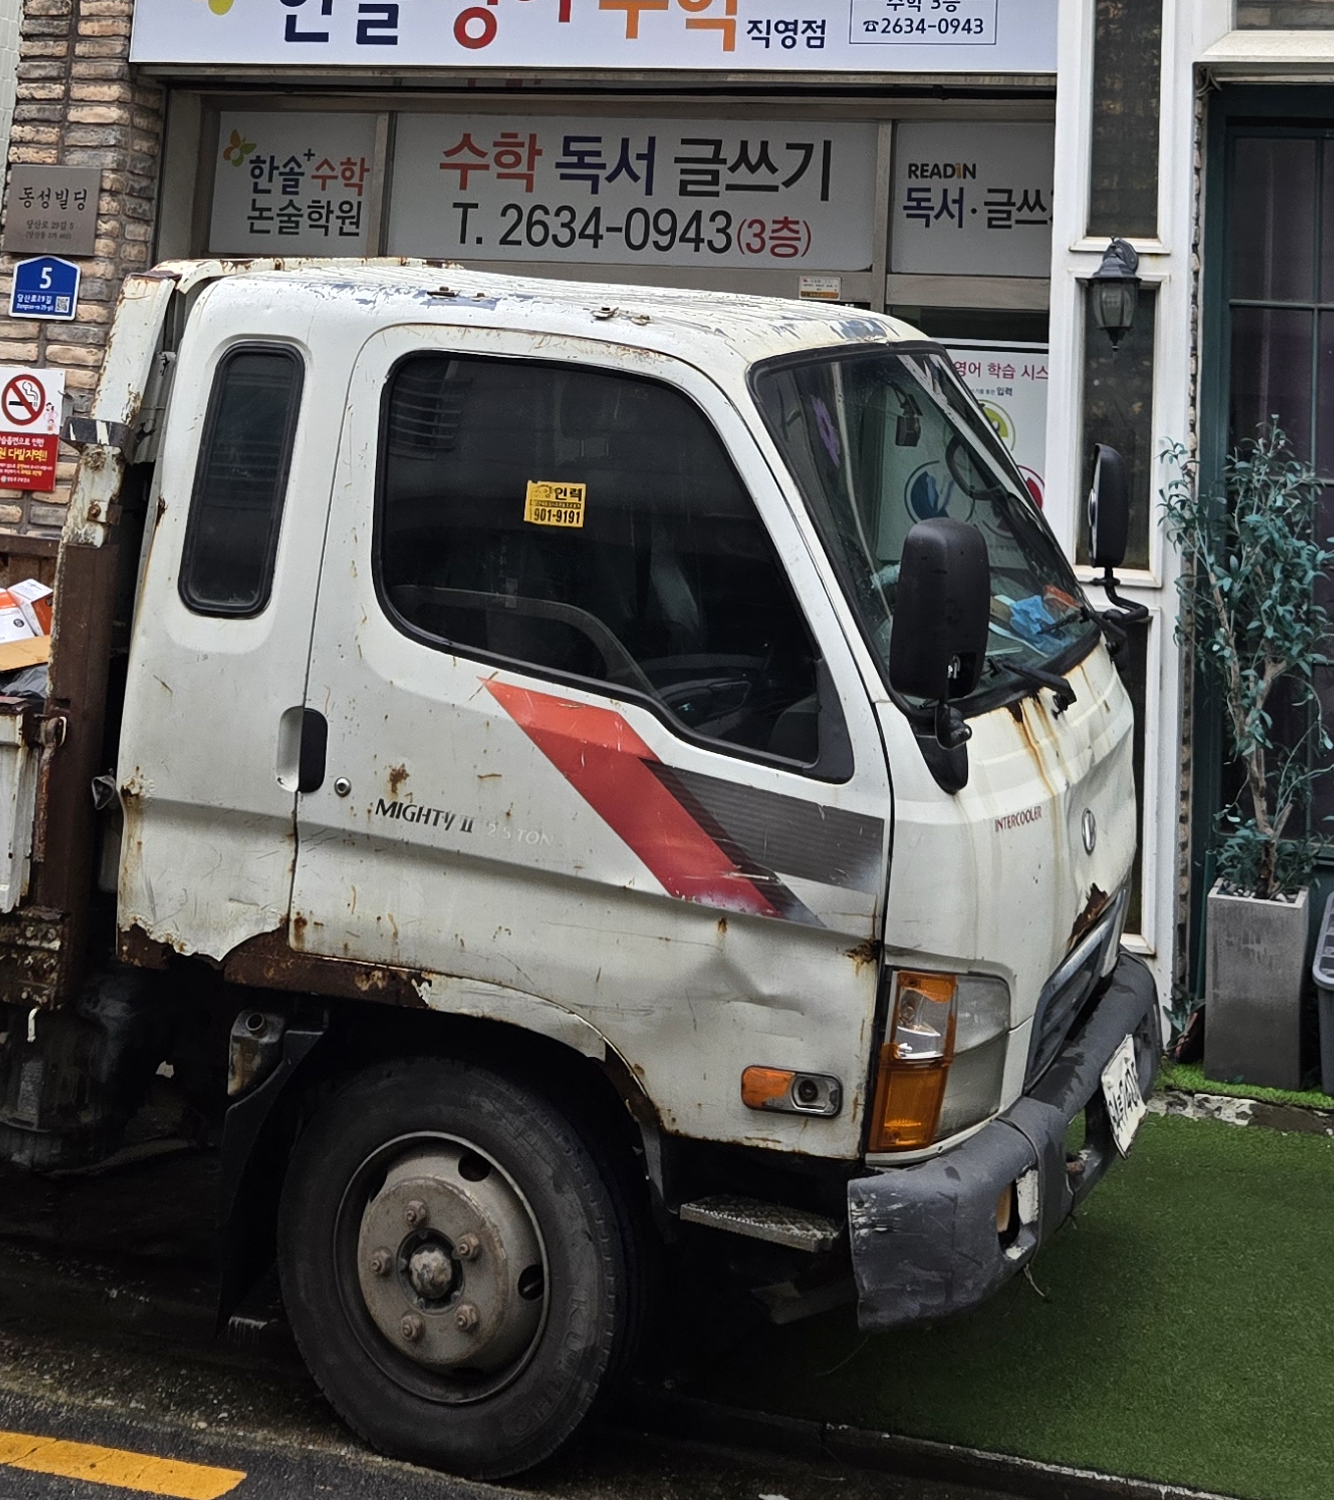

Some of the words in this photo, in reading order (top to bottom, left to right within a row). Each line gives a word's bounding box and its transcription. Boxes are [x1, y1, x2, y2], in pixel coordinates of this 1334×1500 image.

[746, 19, 827, 49] 직영점
[881, 18, 983, 34] 2634-0943
[439, 132, 543, 193] 수학
[555, 135, 656, 196] 독서
[674, 138, 832, 201] 글쓰기
[19, 187, 87, 211] 동성빌딩
[903, 187, 1053, 229] 독서·글쓰
[247, 199, 362, 237] 논술학원
[452, 202, 483, 245] T.
[39, 267, 53, 289] 5
[953, 361, 981, 377] 영어
[987, 362, 1016, 379] 학습
[534, 508, 581, 525] 901-9191
[375, 798, 456, 831] MIGHTY
[517, 828, 554, 847] TON
[995, 805, 1042, 832] INTERCOOLER
